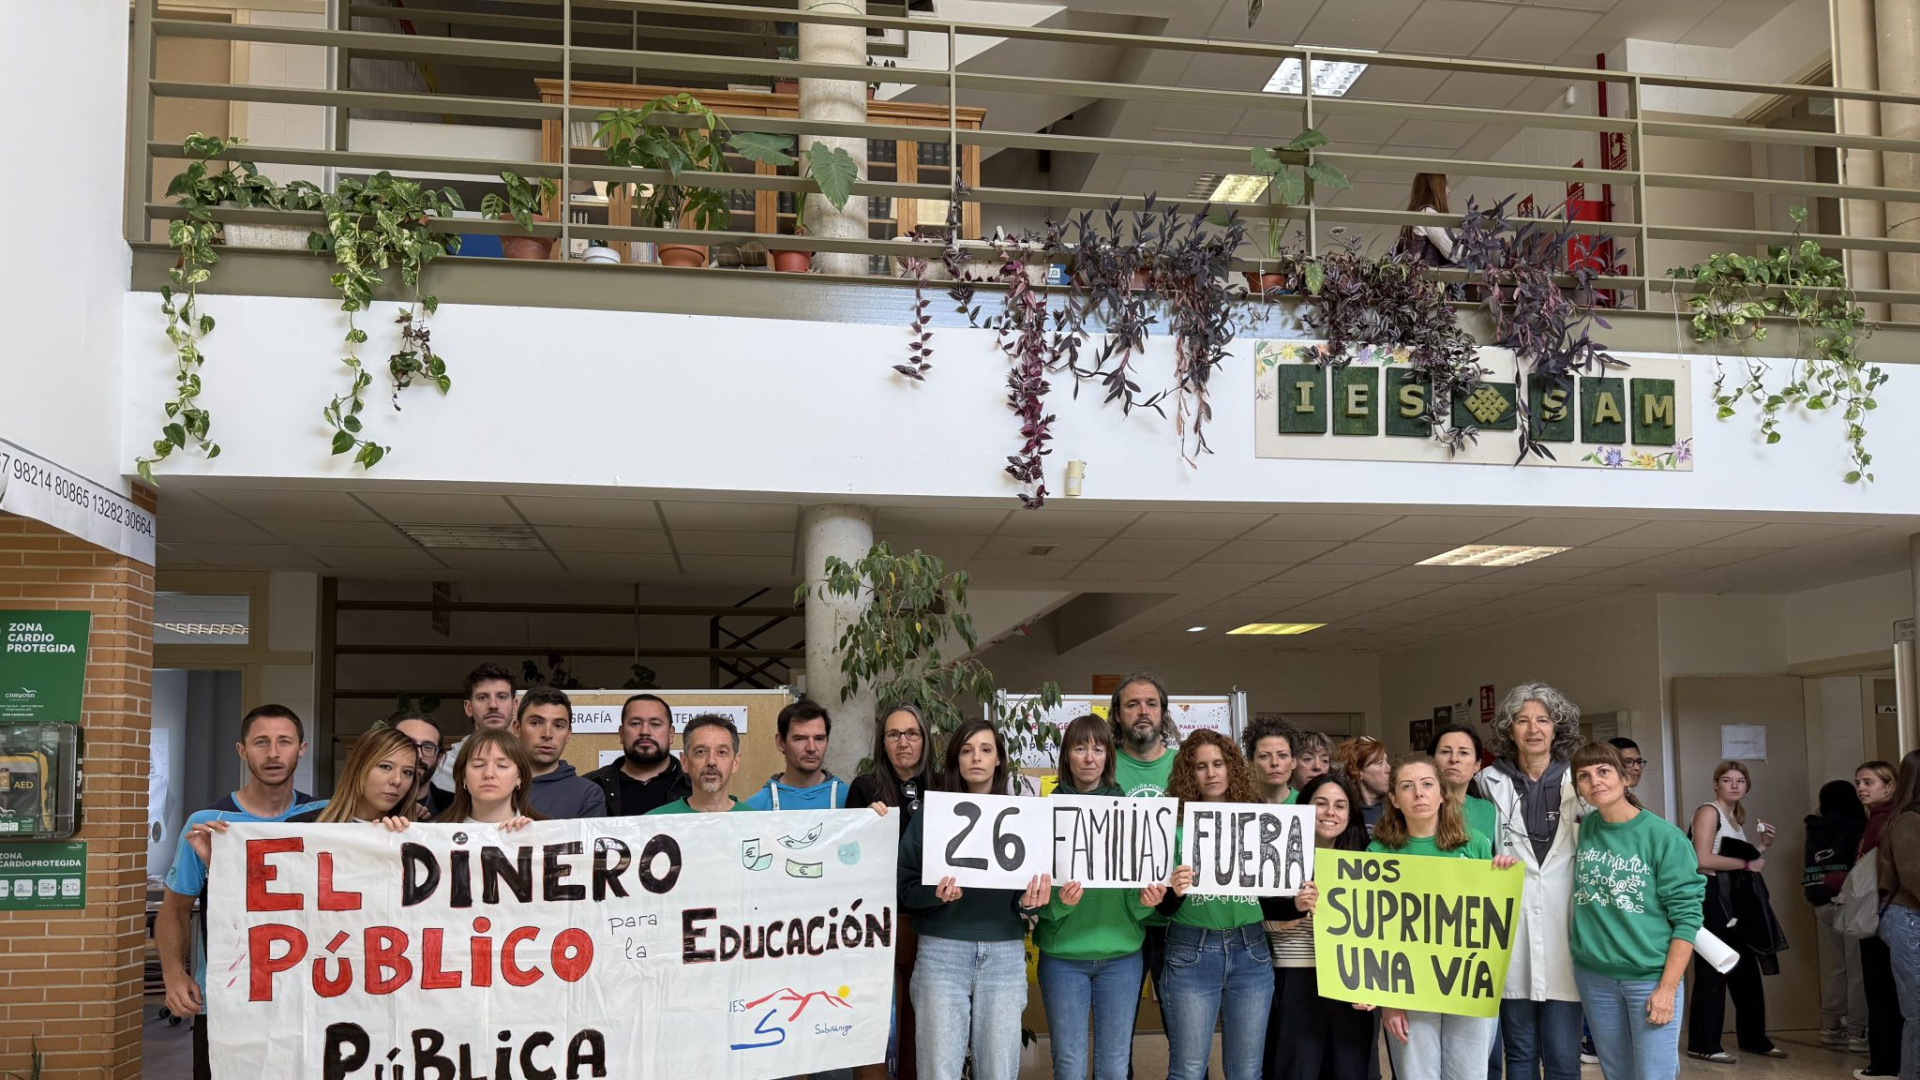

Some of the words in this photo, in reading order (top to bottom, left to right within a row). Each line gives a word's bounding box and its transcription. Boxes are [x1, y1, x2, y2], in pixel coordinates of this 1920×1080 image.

[1296, 380, 1425, 419] IES
[1541, 388, 1675, 428] SAM
[13, 458, 51, 491] 98214
[55, 476, 89, 509] 80865
[92, 494, 122, 524] 13282
[7, 633, 55, 642] CARDIO
[8, 623, 43, 632] ZONA
[6, 644, 76, 653] PROTEGIDA
[13, 781, 34, 790] AED
[945, 801, 1026, 872] 26
[1191, 811, 1307, 889] FUERA
[246, 837, 363, 912] EL
[1337, 858, 1401, 883] NOS
[608, 913, 658, 935] para
[1326, 887, 1515, 950] SUPRIMEN
[625, 938, 647, 960] la
[1336, 944, 1415, 995] UNA
[1431, 952, 1494, 999] VÍA
[729, 999, 746, 1013] IES
